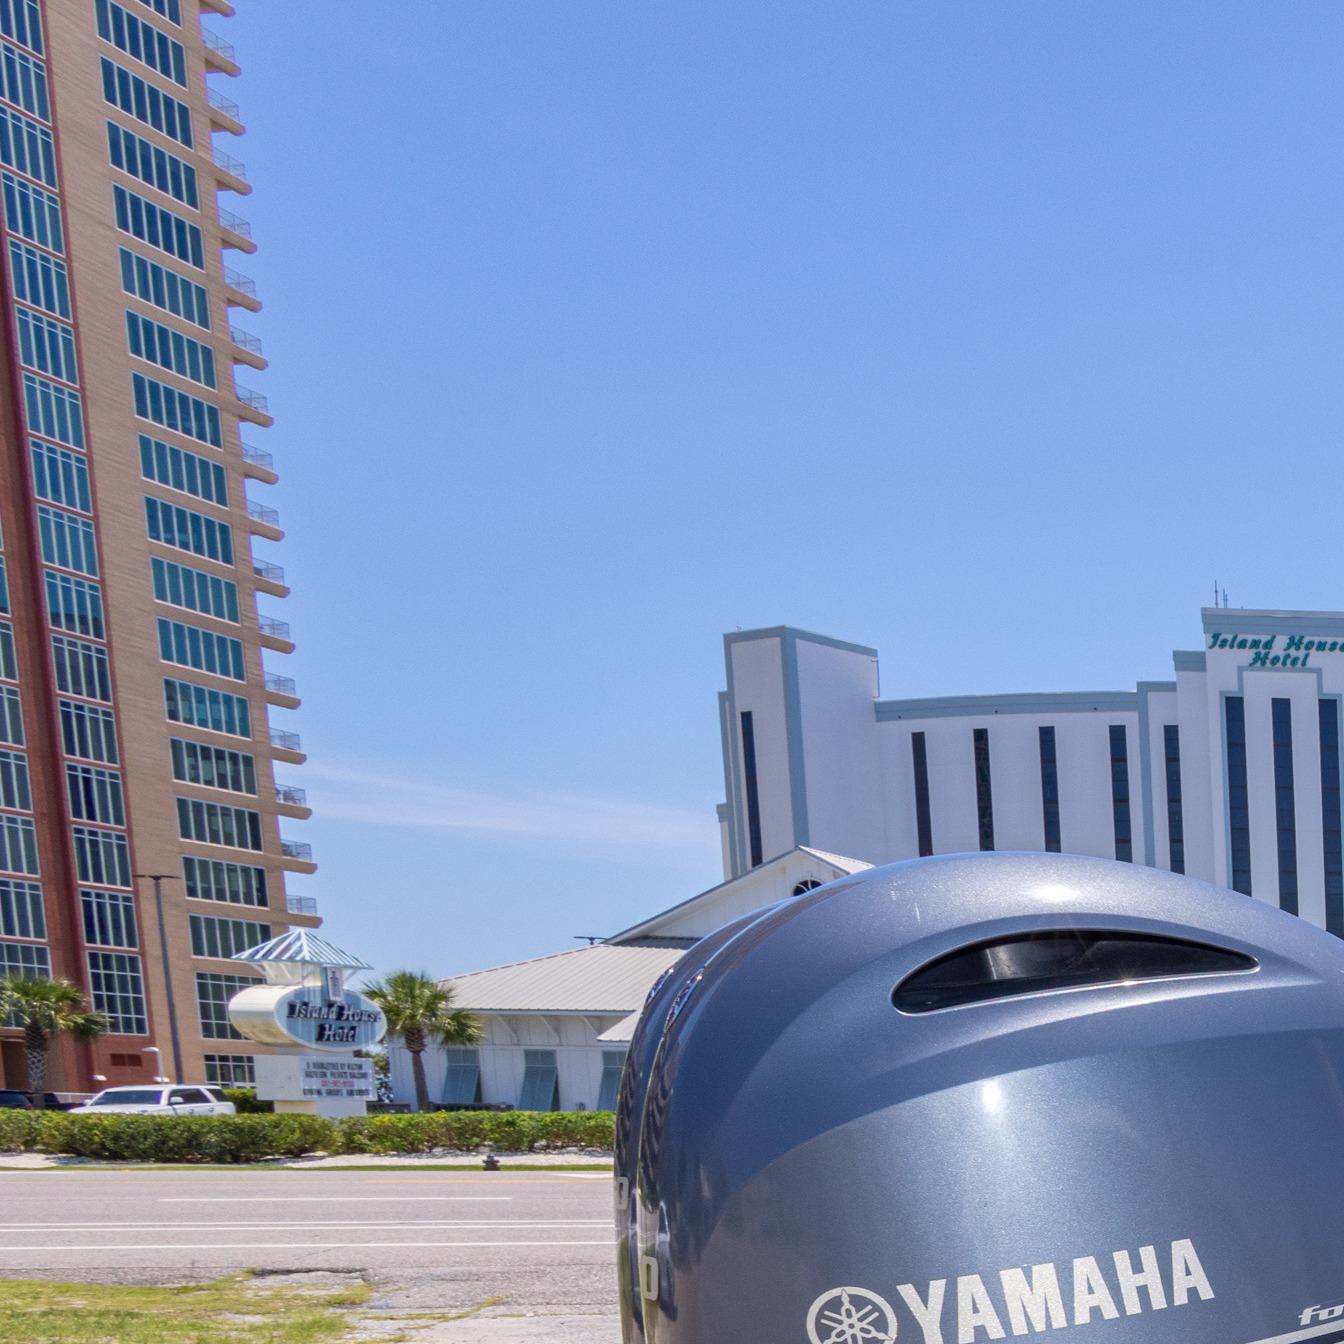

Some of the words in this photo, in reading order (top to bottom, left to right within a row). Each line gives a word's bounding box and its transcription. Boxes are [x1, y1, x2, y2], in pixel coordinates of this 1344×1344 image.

[1208, 633, 1276, 650] Island
[1249, 651, 1310, 667] Hotel
[287, 1001, 337, 1019] Island
[317, 1023, 358, 1042] Hotel
